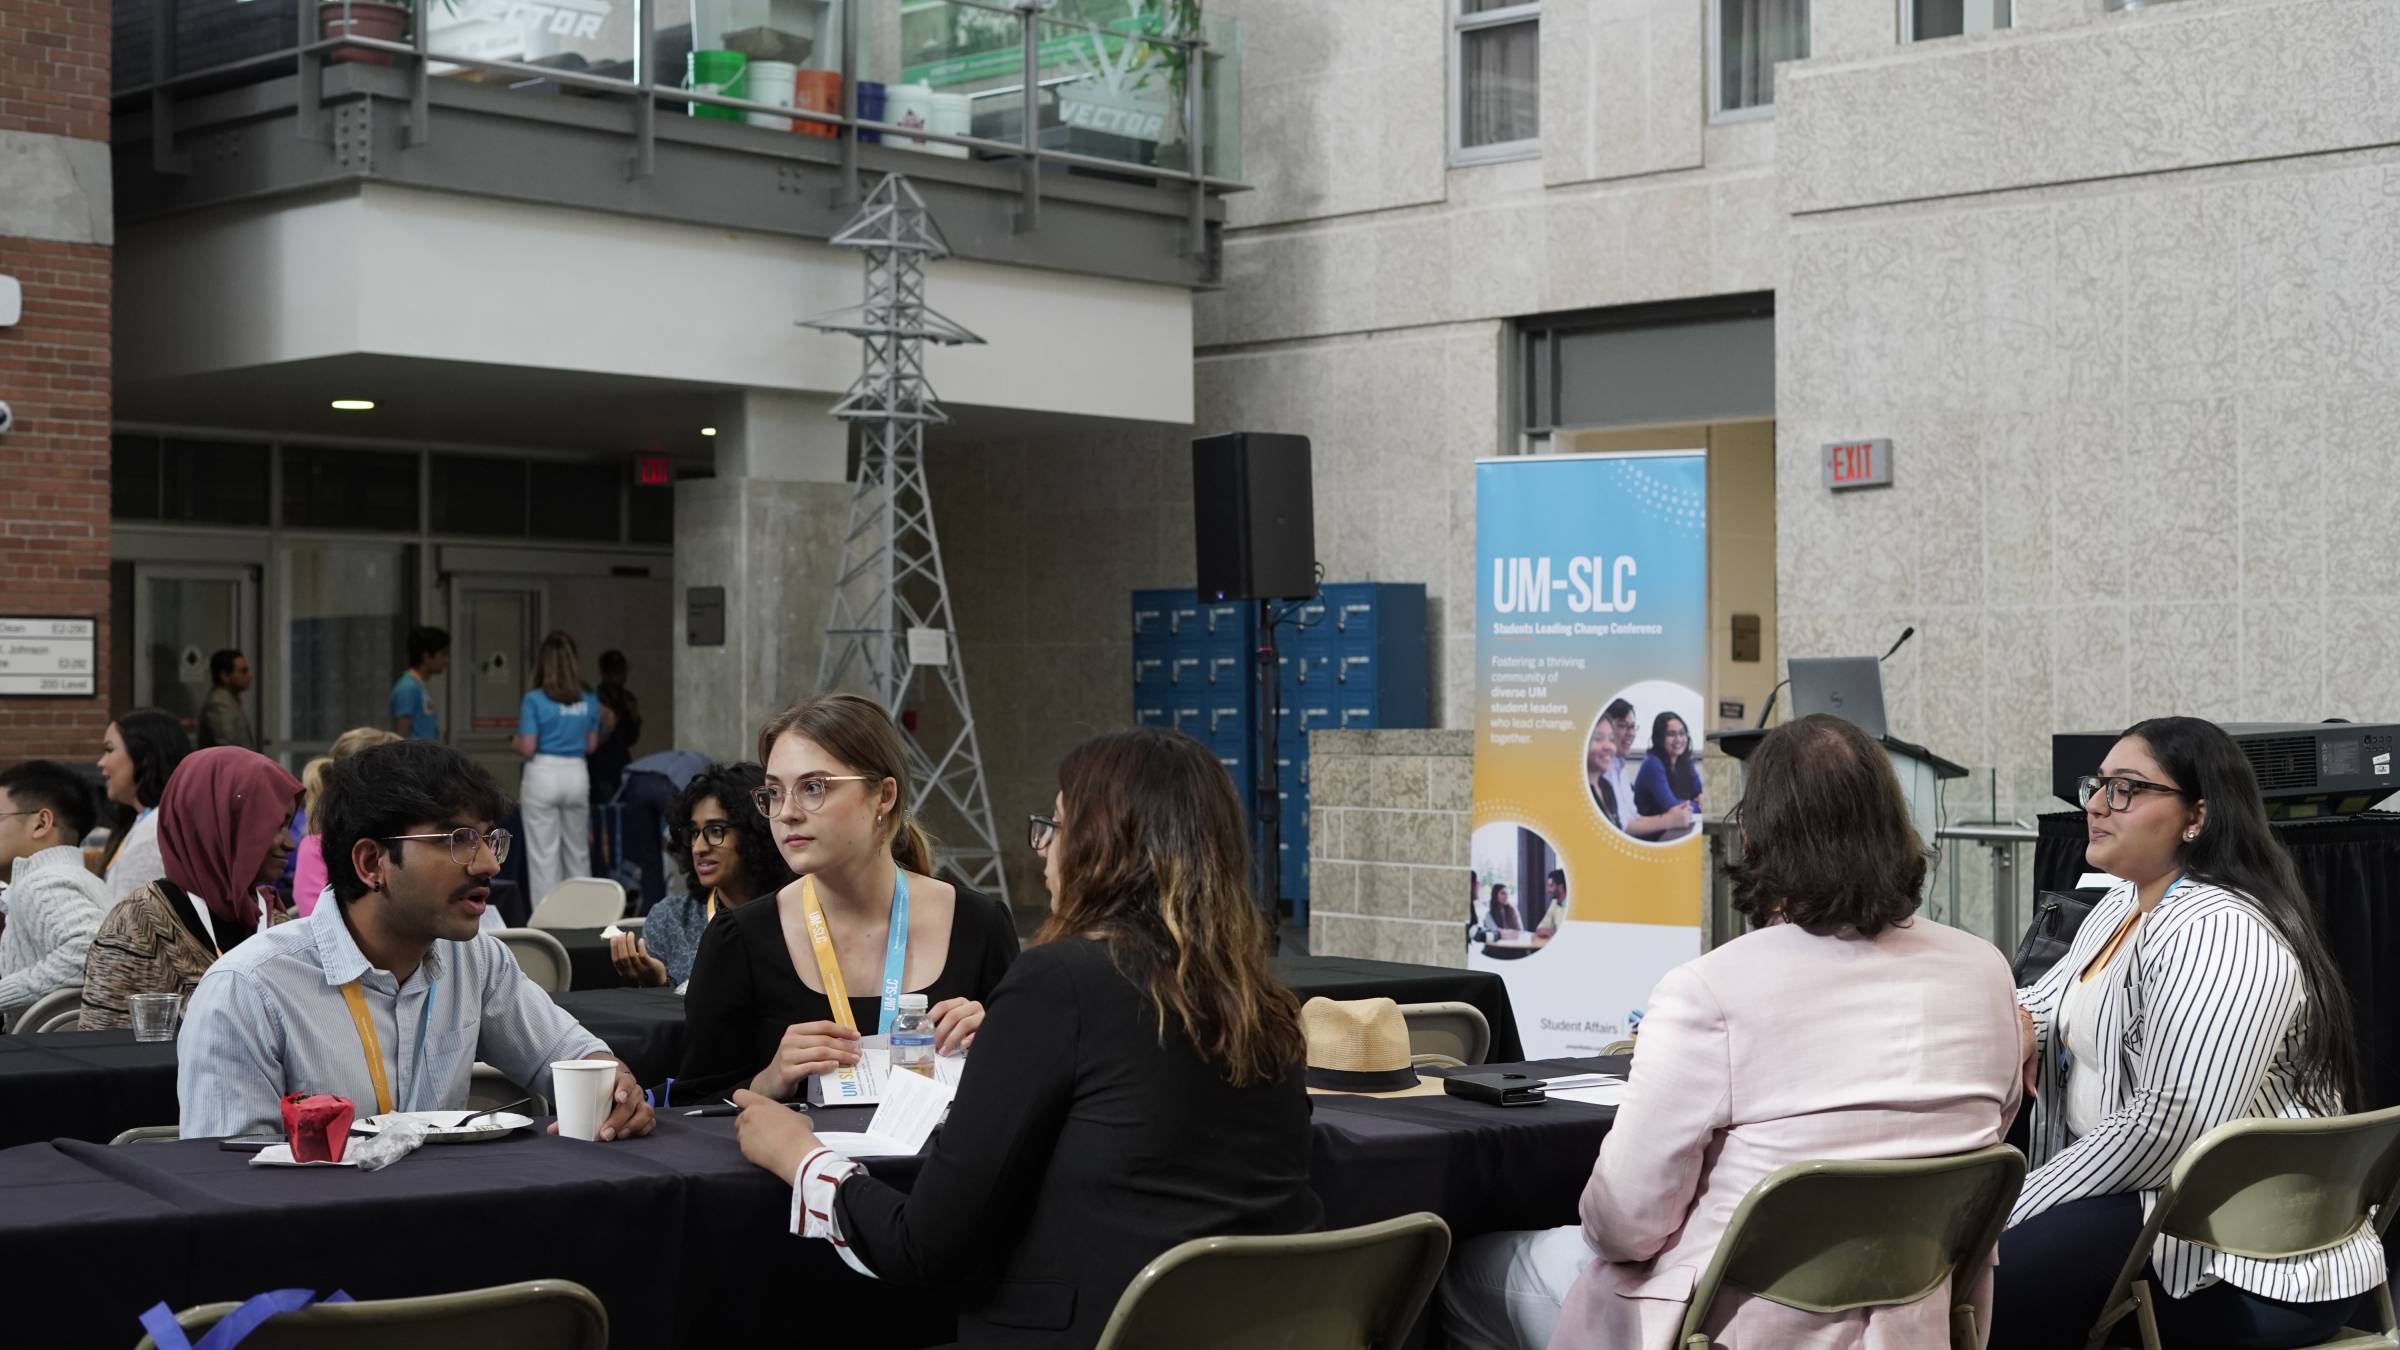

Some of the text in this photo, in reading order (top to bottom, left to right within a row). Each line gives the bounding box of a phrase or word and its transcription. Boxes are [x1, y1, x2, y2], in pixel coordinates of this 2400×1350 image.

[1059, 100, 1163, 141] VECTOR
[1832, 443, 1873, 481] EXIT
[1493, 555, 1637, 614] UM-SLC
[1493, 622, 1662, 637] Students Leading Change Conference
[1491, 656, 1586, 670] Fostering a thriving
[1490, 671, 1559, 685] community of
[1490, 686, 1547, 698] diverse UM
[1490, 702, 1568, 714] student leaders
[1490, 718, 1511, 728] who
[1512, 718, 1534, 728] lead
[1490, 733, 1533, 745] together.
[808, 911, 830, 944] UM-SLC
[883, 978, 898, 1011] UM-SLC
[1540, 1017, 1618, 1035] Student Affairs
[841, 1081, 858, 1097] UM
